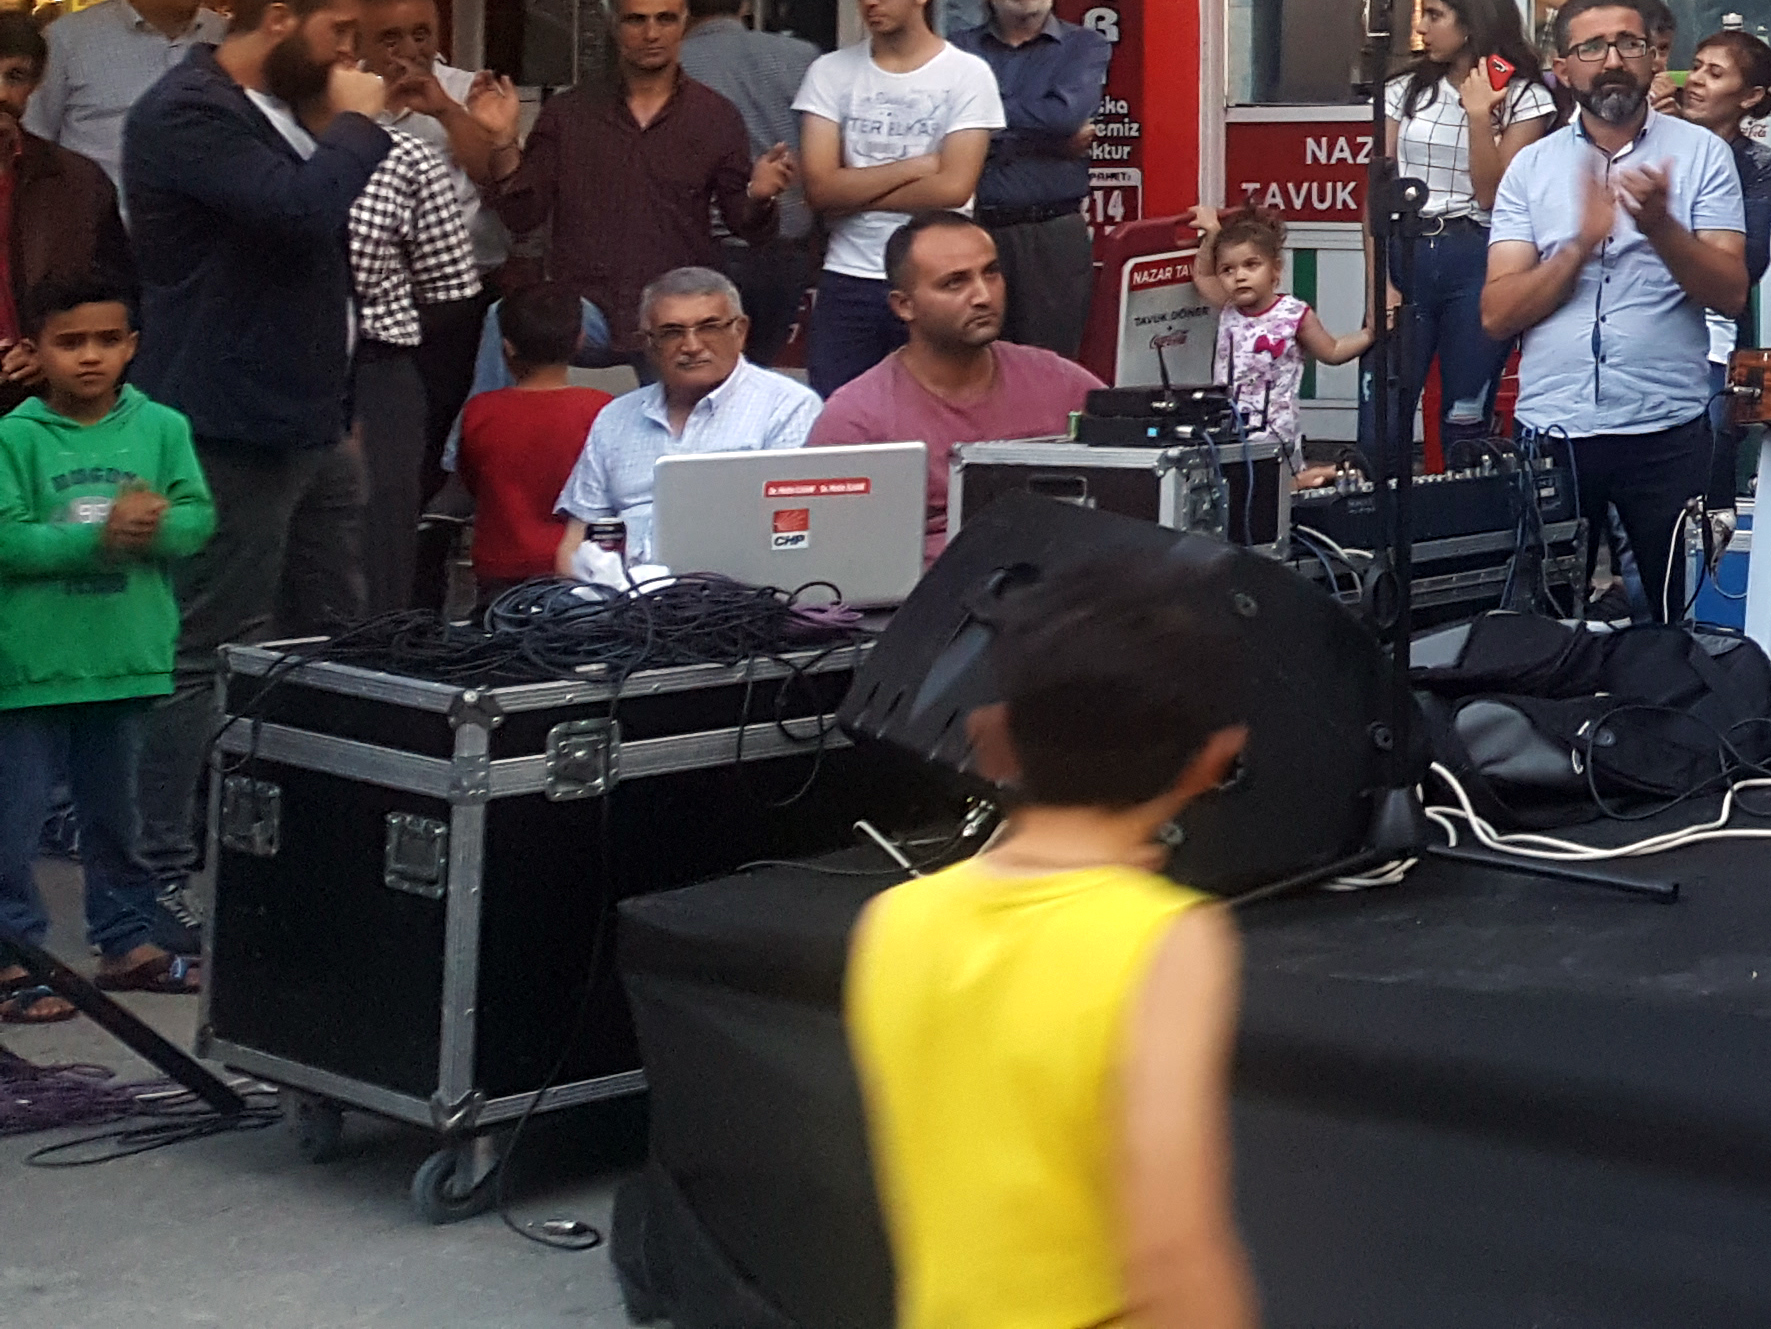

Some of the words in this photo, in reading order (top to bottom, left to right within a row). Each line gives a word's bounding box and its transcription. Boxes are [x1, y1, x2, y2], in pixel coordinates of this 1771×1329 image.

[1305, 136, 1374, 164] NAZ
[1241, 181, 1358, 211] TAVUK
[1132, 266, 1173, 285] NAZAR
[774, 534, 806, 547] CHP
